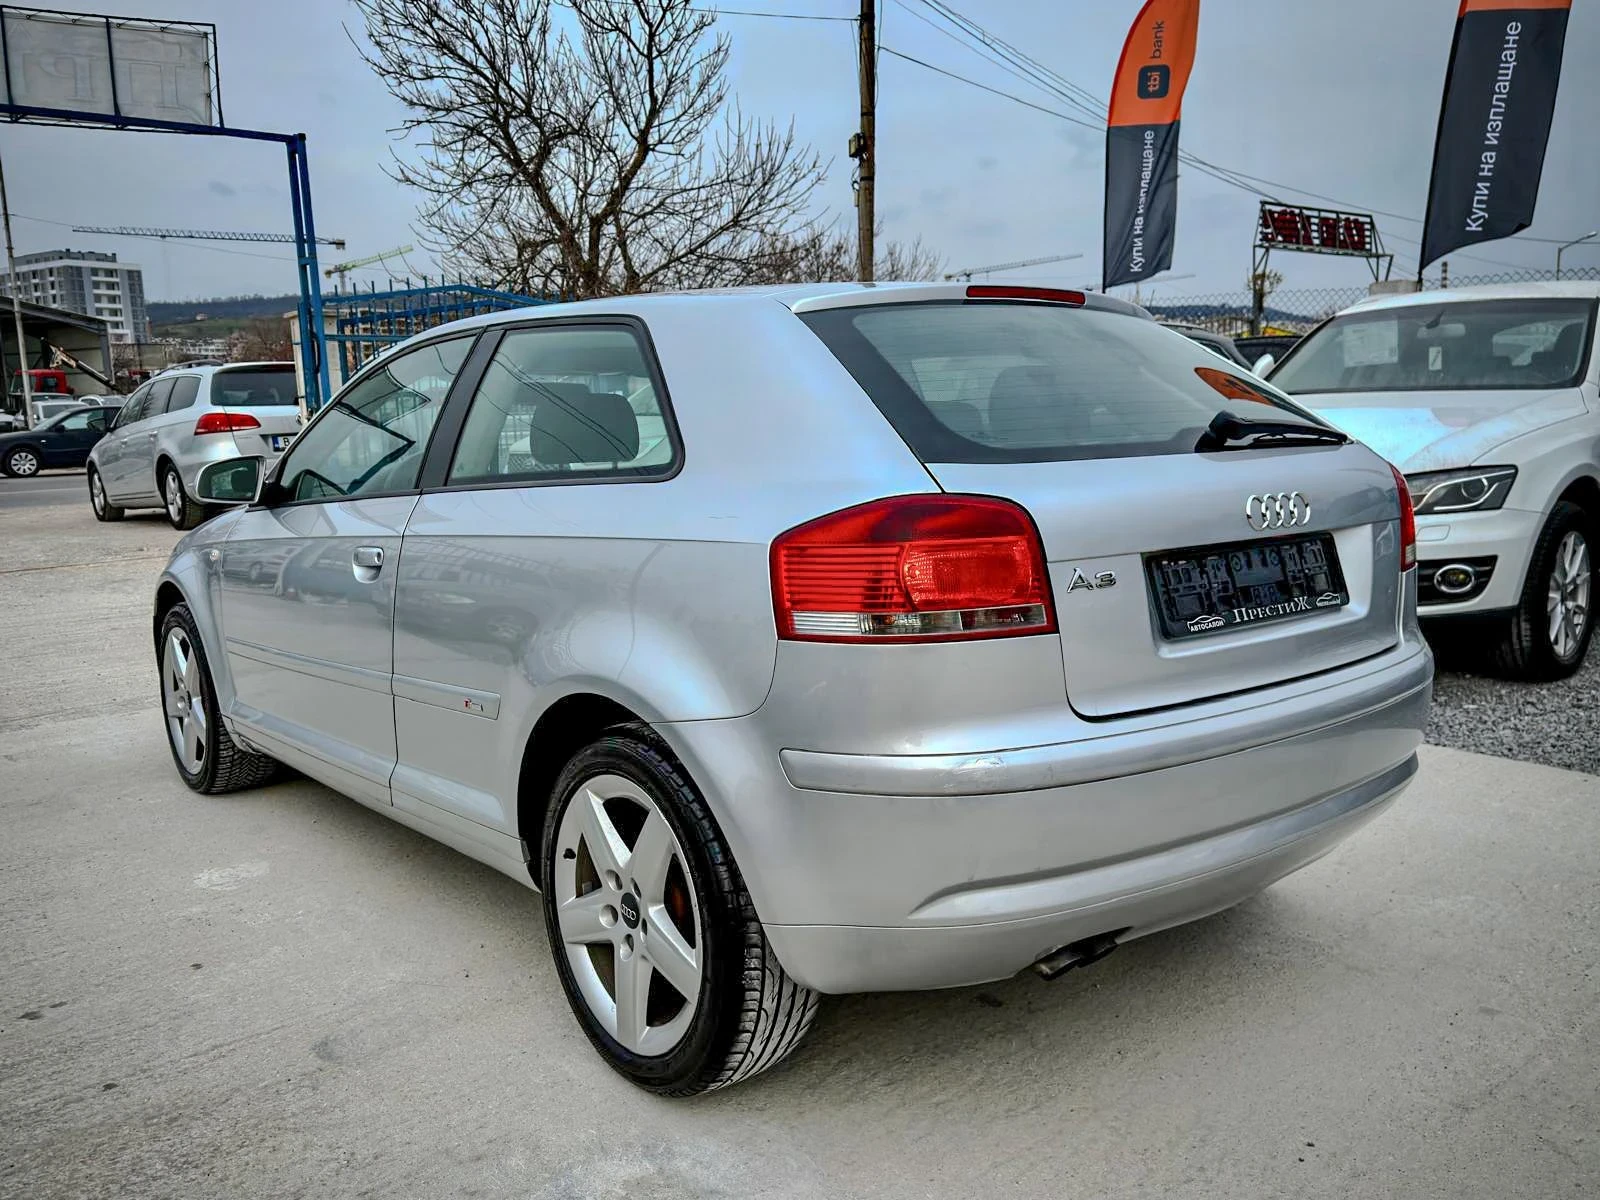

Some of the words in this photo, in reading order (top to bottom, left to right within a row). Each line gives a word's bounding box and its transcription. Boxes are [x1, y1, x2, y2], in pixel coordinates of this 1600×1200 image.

[1148, 20, 1165, 59] bank
[1147, 71, 1160, 92] tbi
[1484, 20, 1522, 145] изплащане
[1137, 130, 1155, 214] изплащане
[1478, 150, 1497, 177] на
[1465, 181, 1491, 232] Купи
[1133, 216, 1144, 235] на
[1130, 236, 1145, 273] Купи
[1067, 567, 1117, 593] A3
[1190, 620, 1224, 632] АВТОСАЛОН
